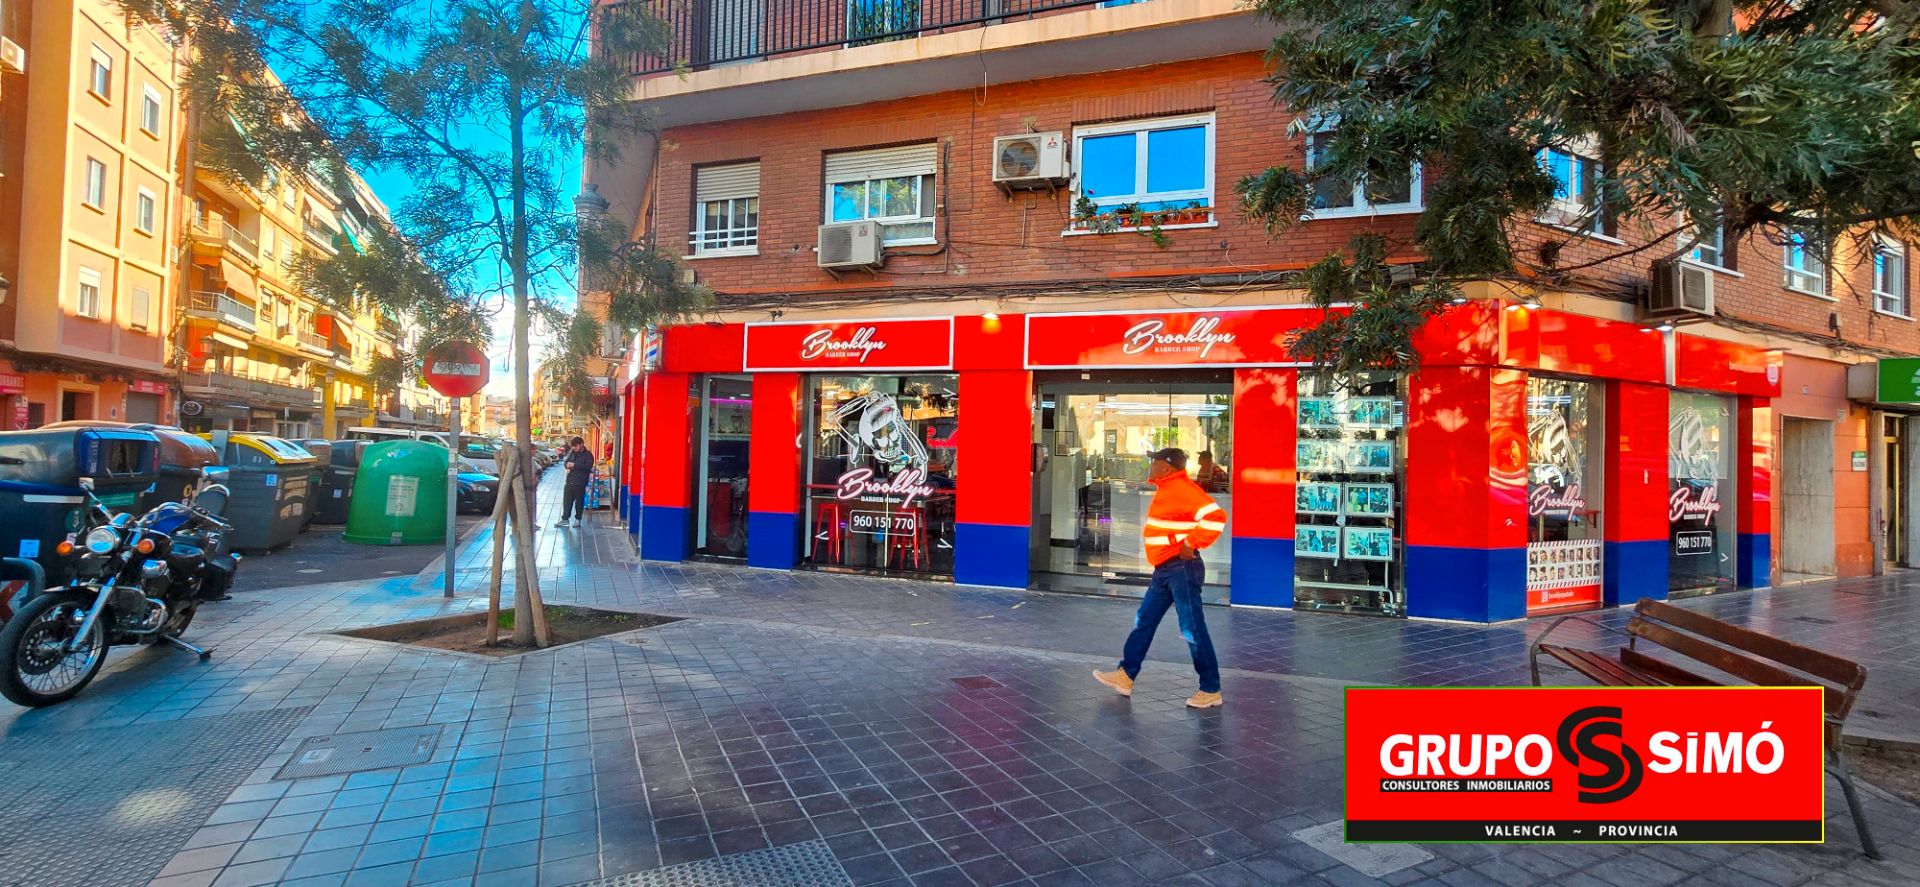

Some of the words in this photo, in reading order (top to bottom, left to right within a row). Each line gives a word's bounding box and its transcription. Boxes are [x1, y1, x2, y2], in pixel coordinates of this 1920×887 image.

[801, 326, 887, 363] Brooklyn
[1122, 316, 1236, 359] Brooklyn
[837, 467, 935, 508] Brooklyn
[860, 495, 884, 503] BARBER
[1529, 484, 1585, 521] Brooklyn
[1669, 486, 1721, 526] Brooklyn
[853, 515, 872, 527] 960
[875, 516, 891, 528] 151
[895, 517, 913, 530] 770
[1678, 537, 1689, 549] 960
[1690, 537, 1700, 548] 151
[1701, 536, 1712, 547] 770
